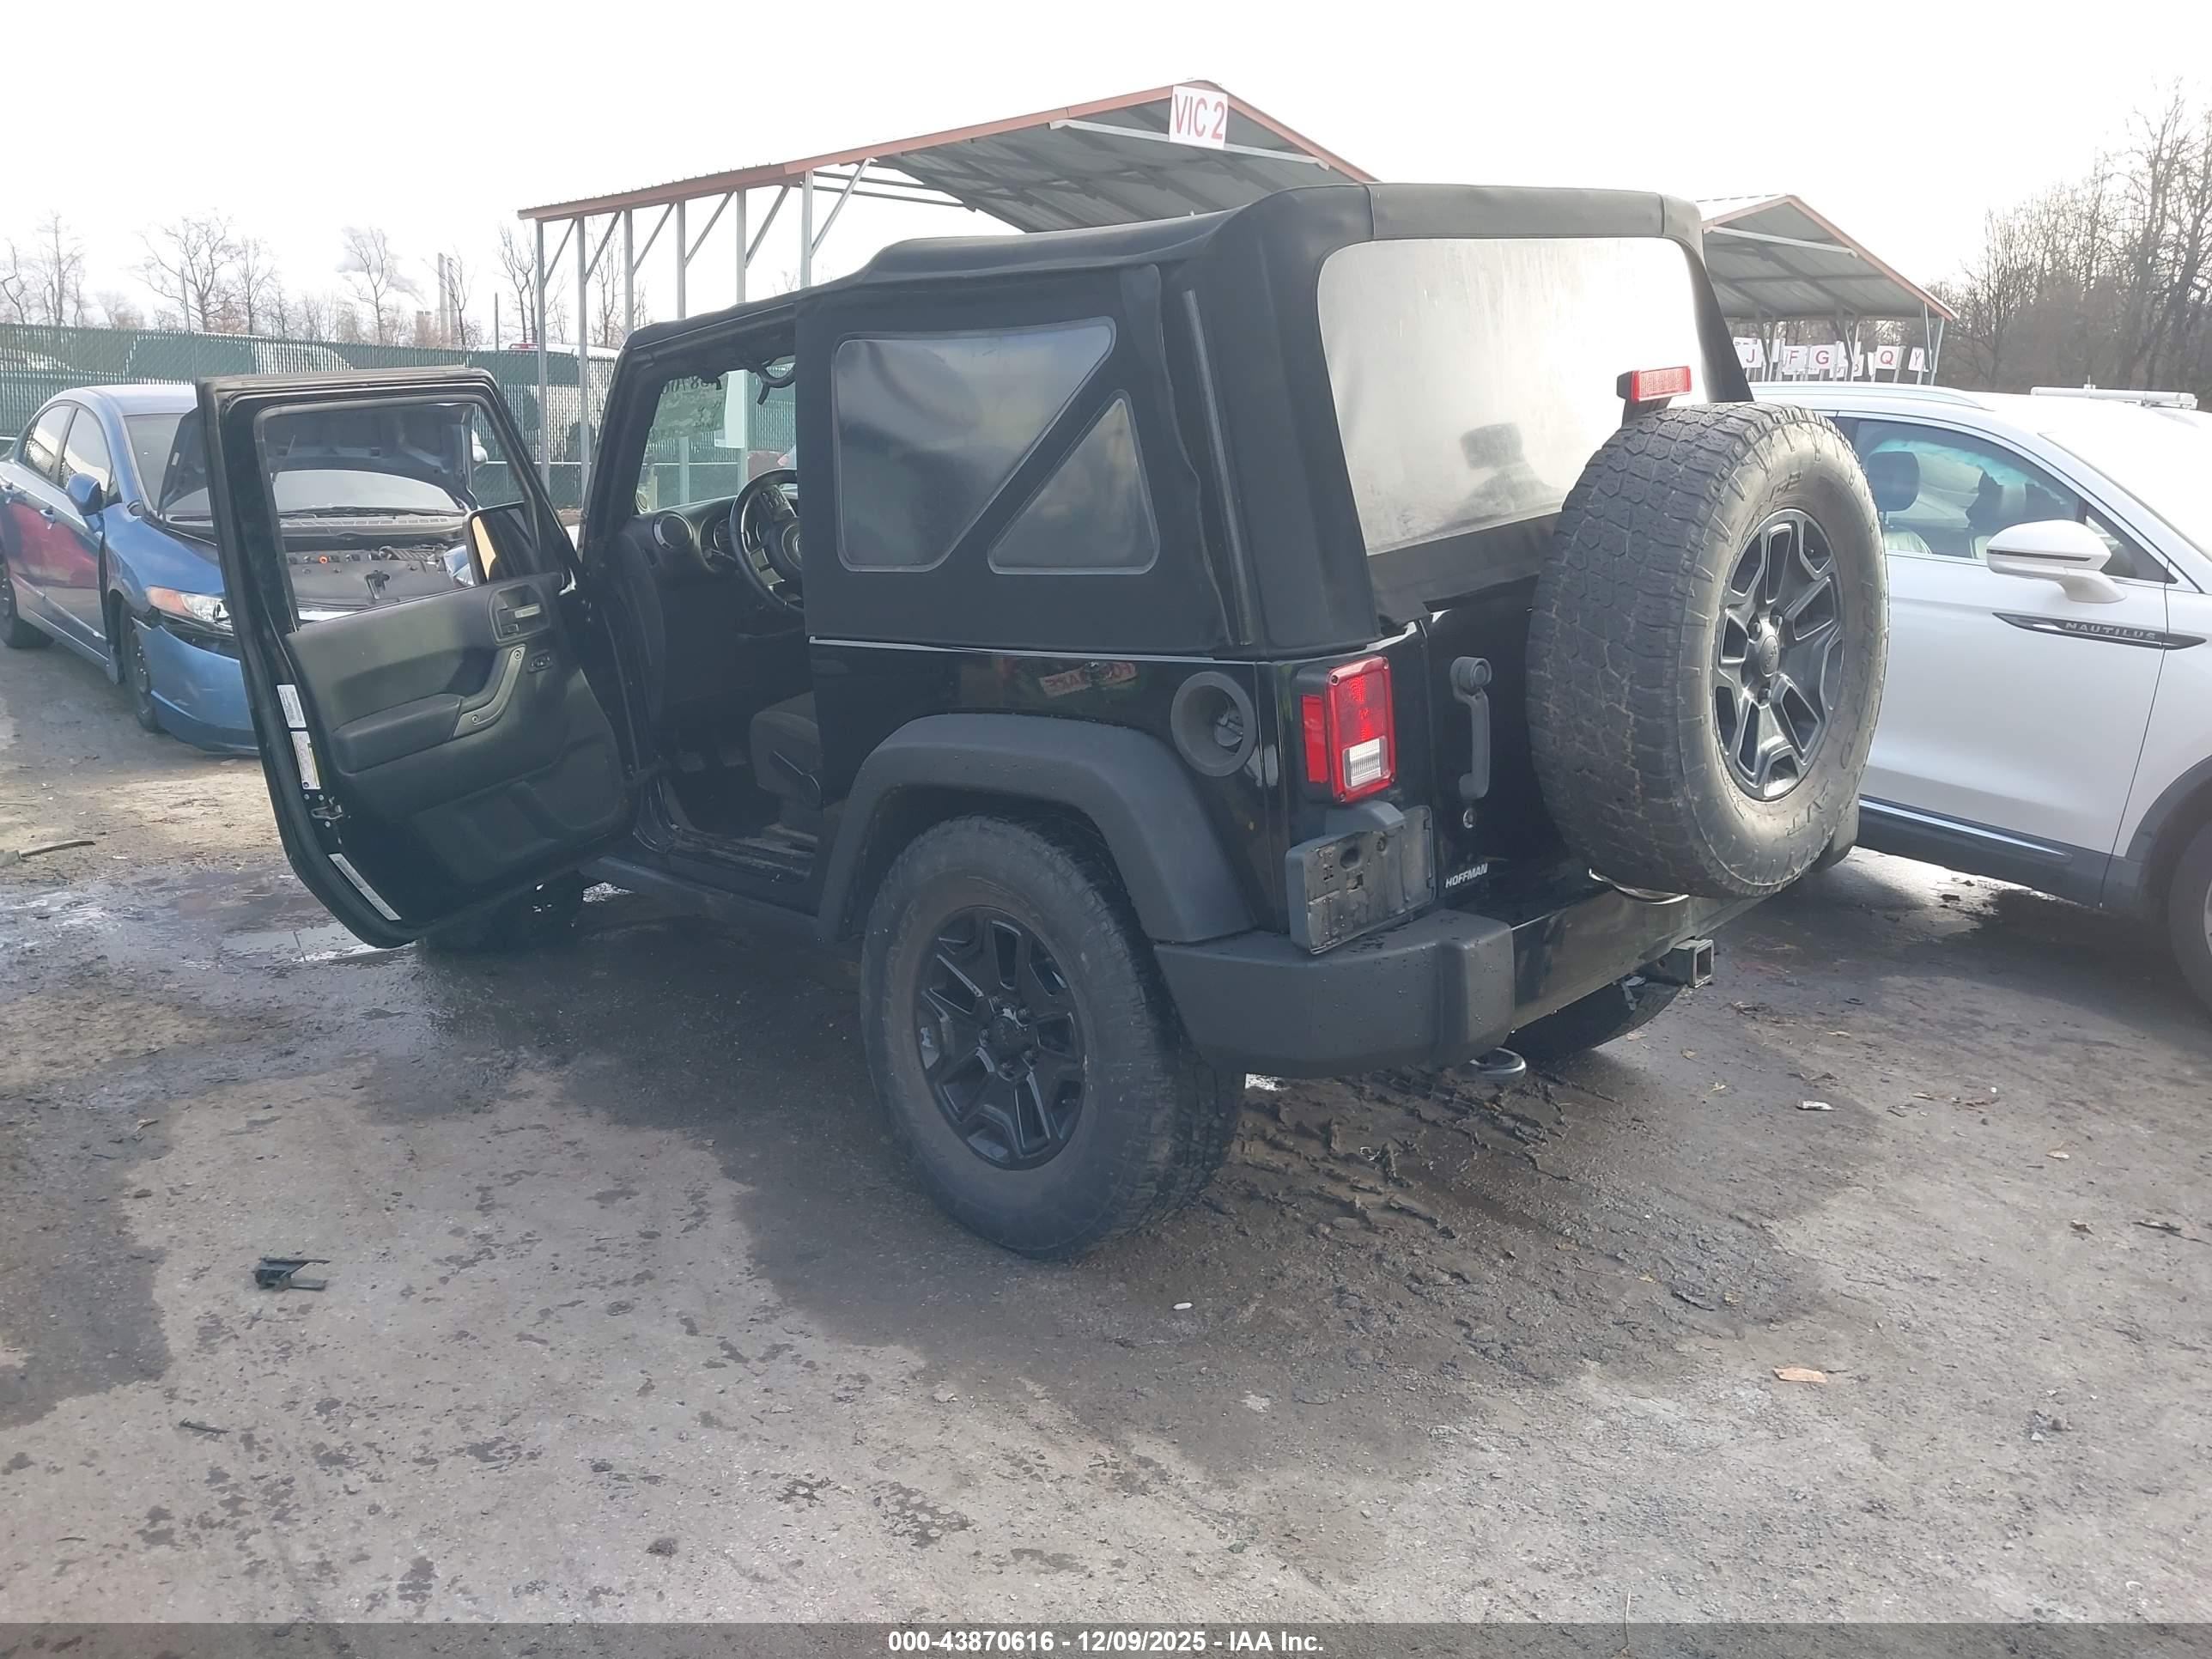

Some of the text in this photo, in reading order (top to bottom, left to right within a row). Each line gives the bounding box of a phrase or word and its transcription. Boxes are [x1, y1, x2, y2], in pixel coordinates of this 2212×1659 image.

[1175, 94, 1225, 140] VIC 2
[1745, 349, 1756, 363] J
[1789, 349, 1800, 365] F
[1815, 349, 1829, 365] G
[1880, 349, 1893, 366] Q
[1914, 351, 1922, 366] Y
[2064, 622, 2156, 641] NAUTILUS
[1445, 862, 1488, 889] HOFFMAN
